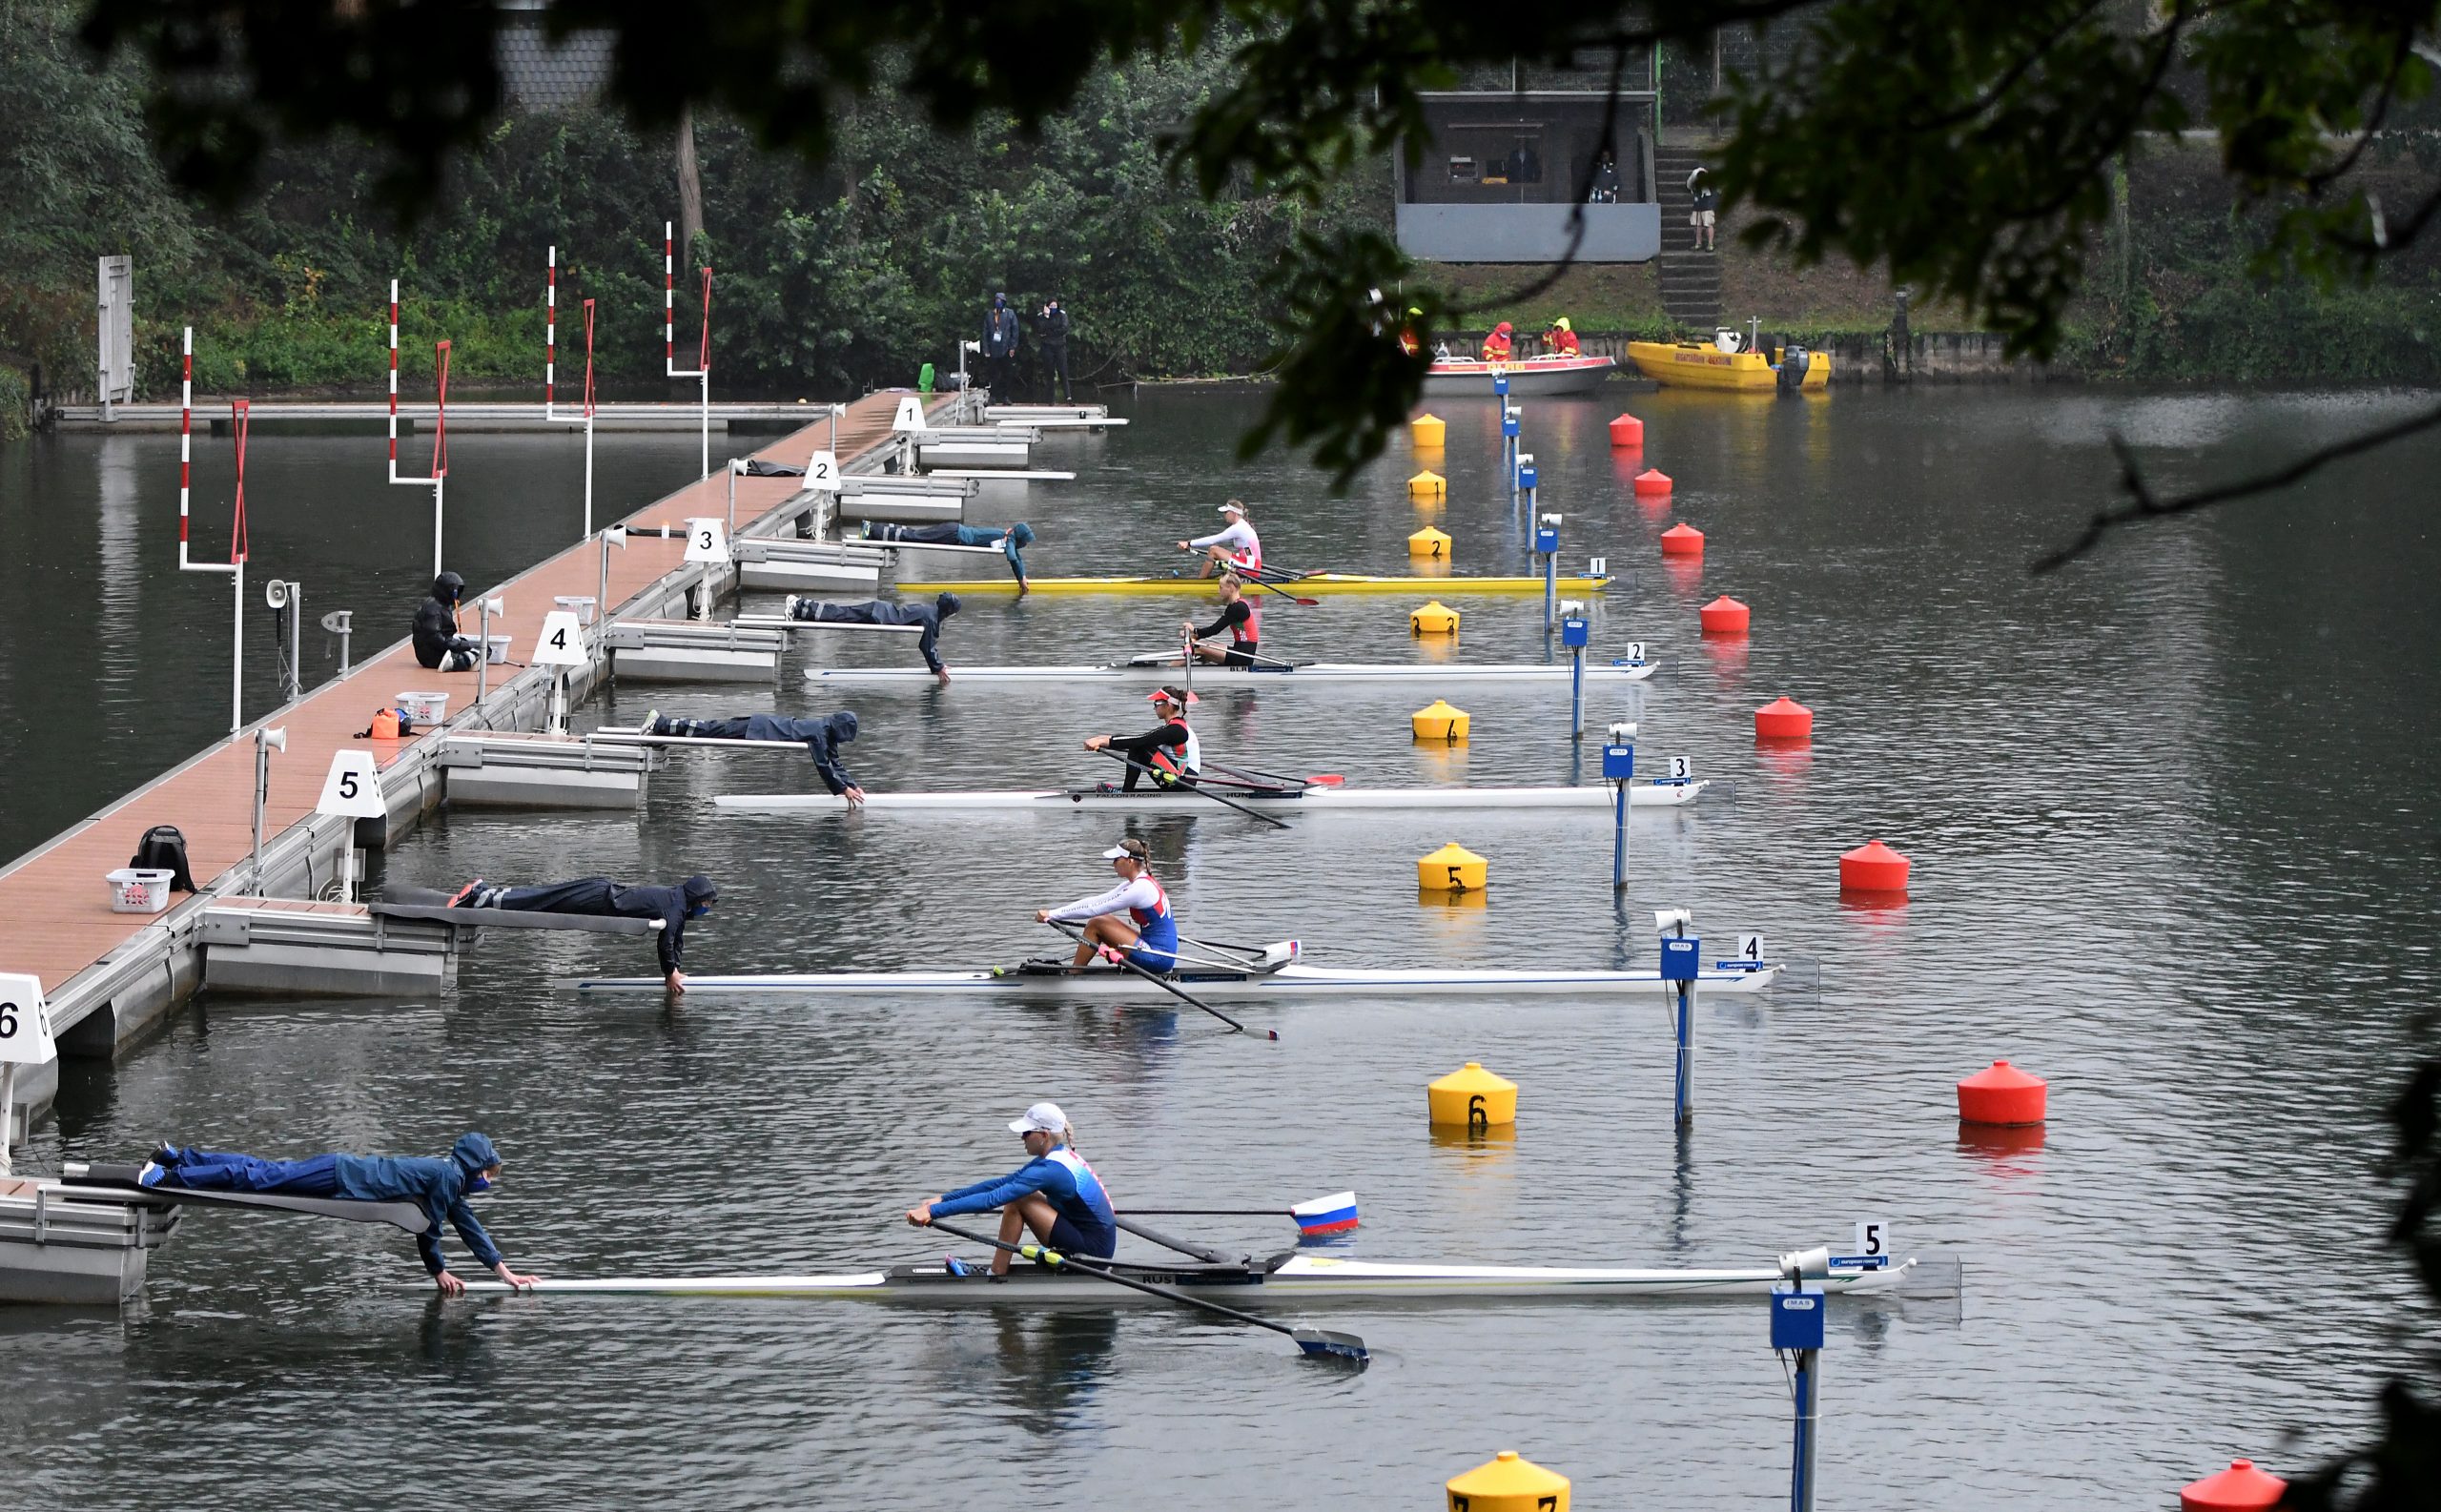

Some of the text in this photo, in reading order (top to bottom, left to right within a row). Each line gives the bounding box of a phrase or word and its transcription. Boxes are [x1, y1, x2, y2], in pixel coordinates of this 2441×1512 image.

[906, 407, 913, 421] 1
[816, 463, 828, 480] 2
[699, 531, 712, 550] 3
[1432, 541, 1442, 556] 2
[550, 628, 566, 650] 4
[1632, 644, 1641, 660] 2
[1675, 758, 1686, 777] 3
[338, 771, 359, 799] 5
[1447, 866, 1465, 889] 5
[1745, 936, 1758, 960] 4
[0, 1002, 19, 1039] 6
[38, 1001, 48, 1037] 6
[1468, 1094, 1487, 1125] 6
[1865, 1225, 1880, 1256] 5
[1143, 1276, 1172, 1284] RUS
